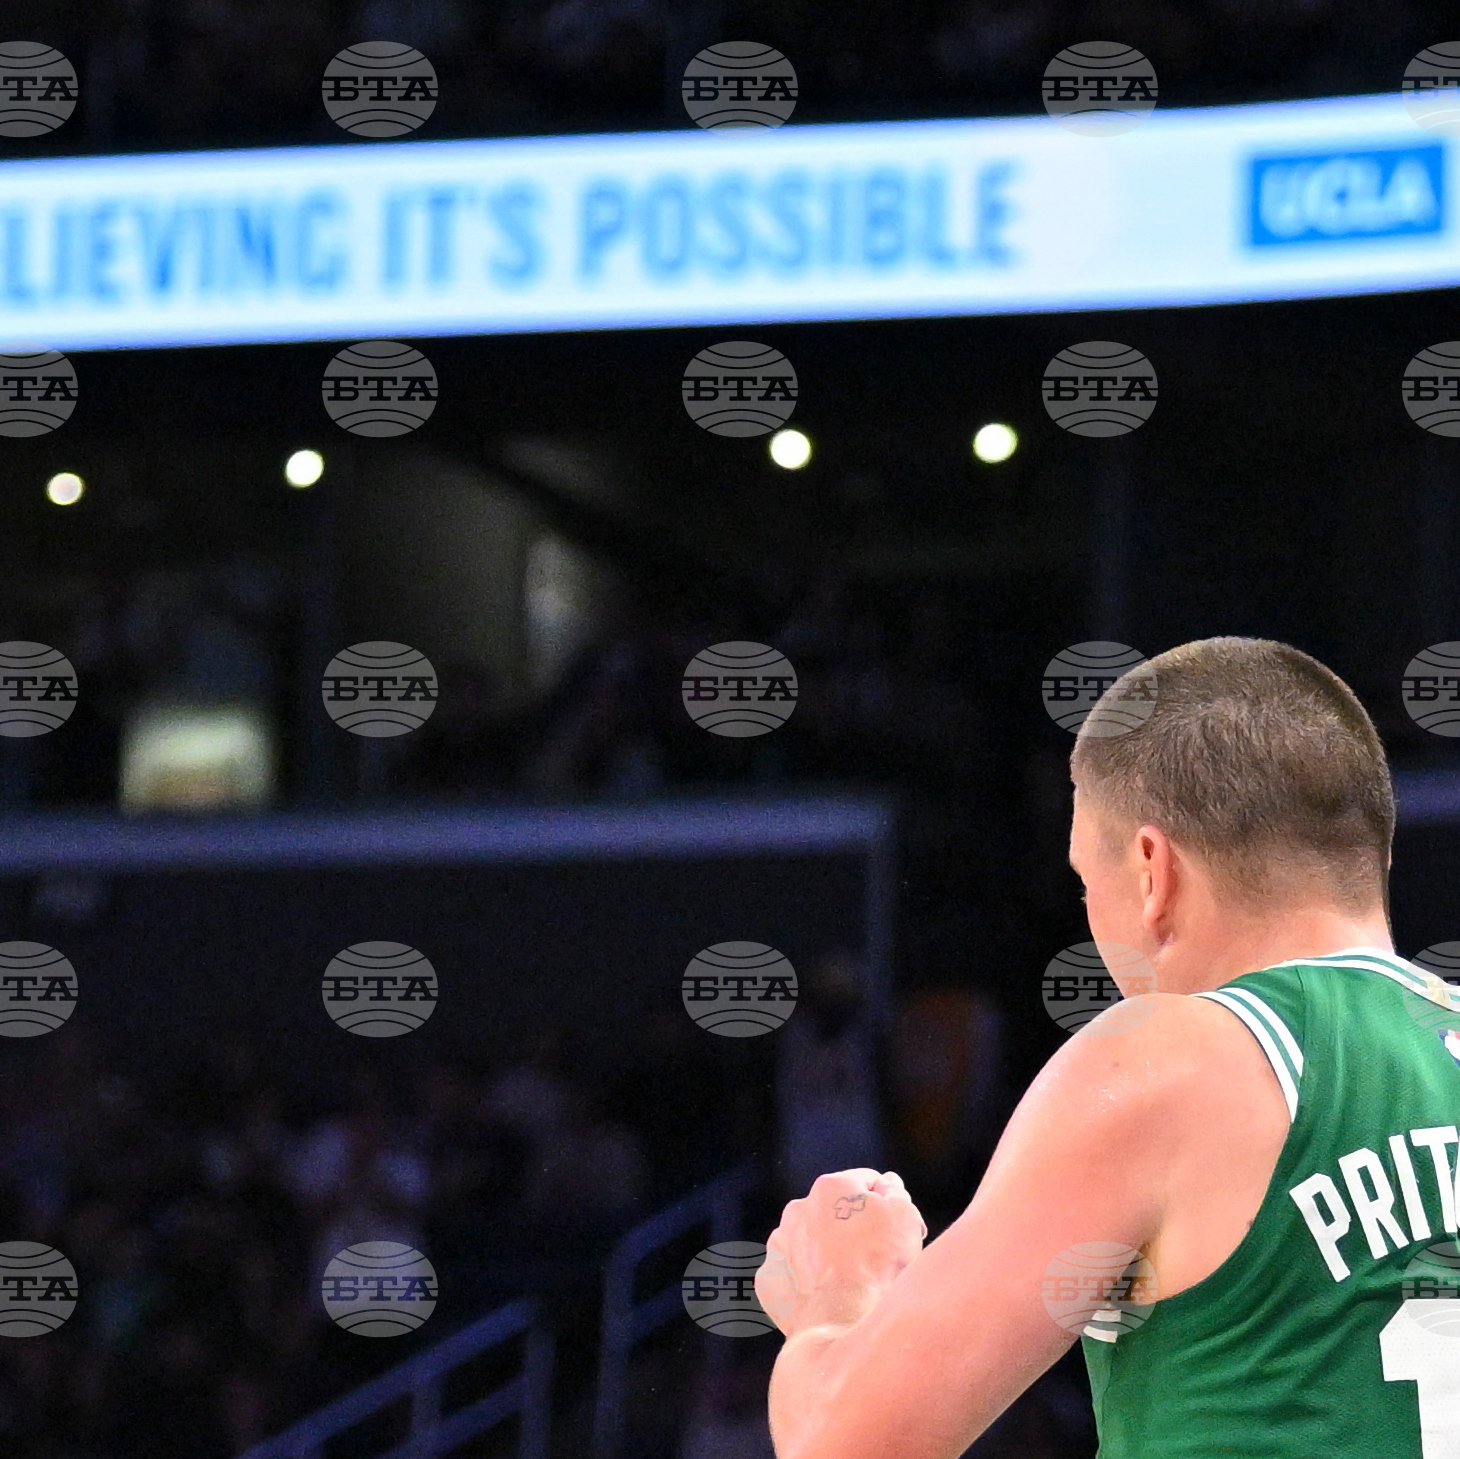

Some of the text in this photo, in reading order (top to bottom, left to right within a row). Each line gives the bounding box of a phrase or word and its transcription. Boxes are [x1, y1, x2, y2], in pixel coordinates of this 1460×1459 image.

[382, 180, 545, 291] IT'S
[580, 158, 1020, 283] POSSIBLE
[1258, 156, 1437, 238] UCLA
